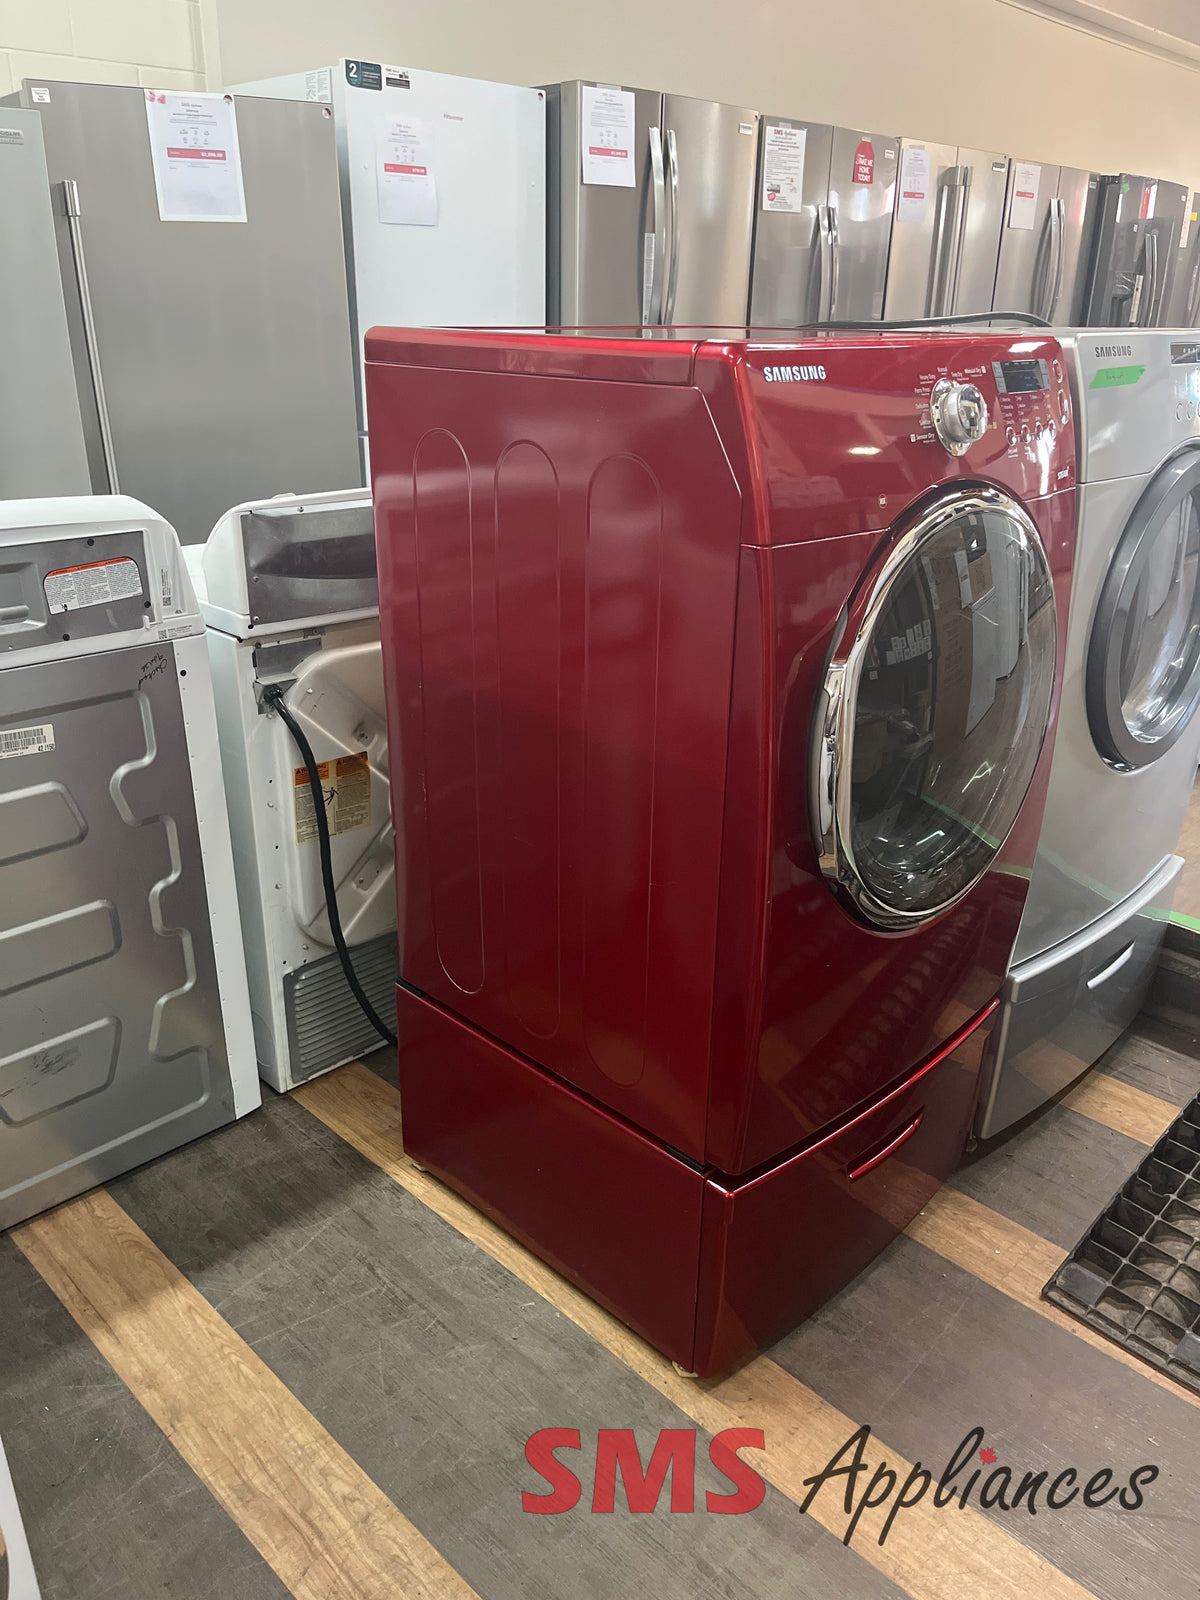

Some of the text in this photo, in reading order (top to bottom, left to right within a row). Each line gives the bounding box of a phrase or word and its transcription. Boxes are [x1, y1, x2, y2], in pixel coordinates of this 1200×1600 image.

[348, 62, 358, 78] 2
[1094, 345, 1132, 358] SAMSUNG
[763, 364, 827, 382] SAMSUNG
